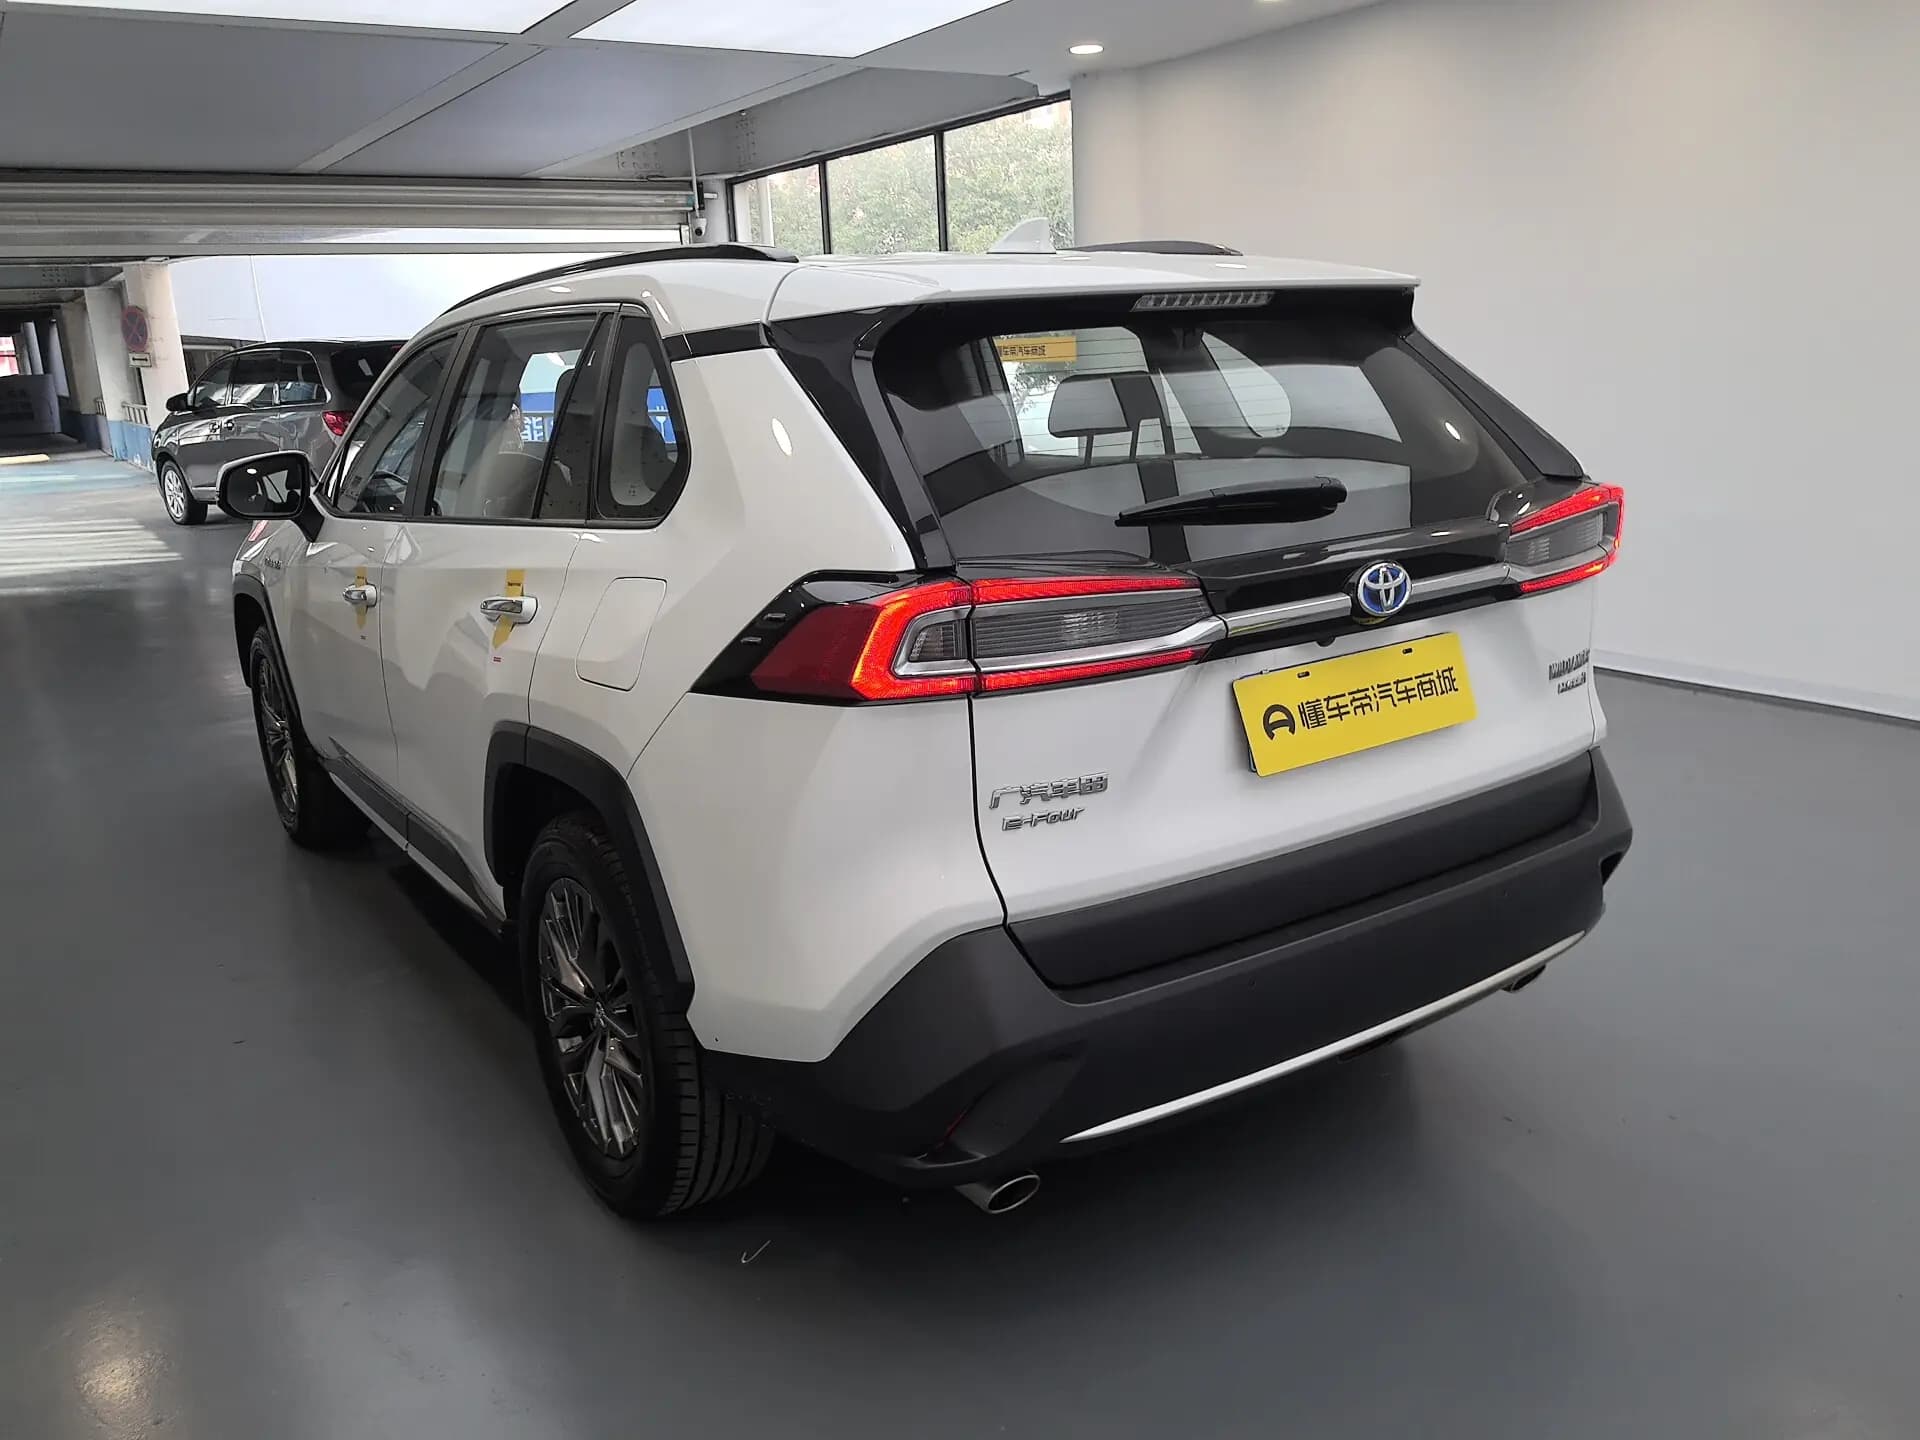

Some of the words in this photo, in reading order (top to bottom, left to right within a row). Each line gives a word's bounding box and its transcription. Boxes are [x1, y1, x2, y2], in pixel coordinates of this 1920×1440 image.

[1298, 666, 1459, 730] 懂车帝汽车商城
